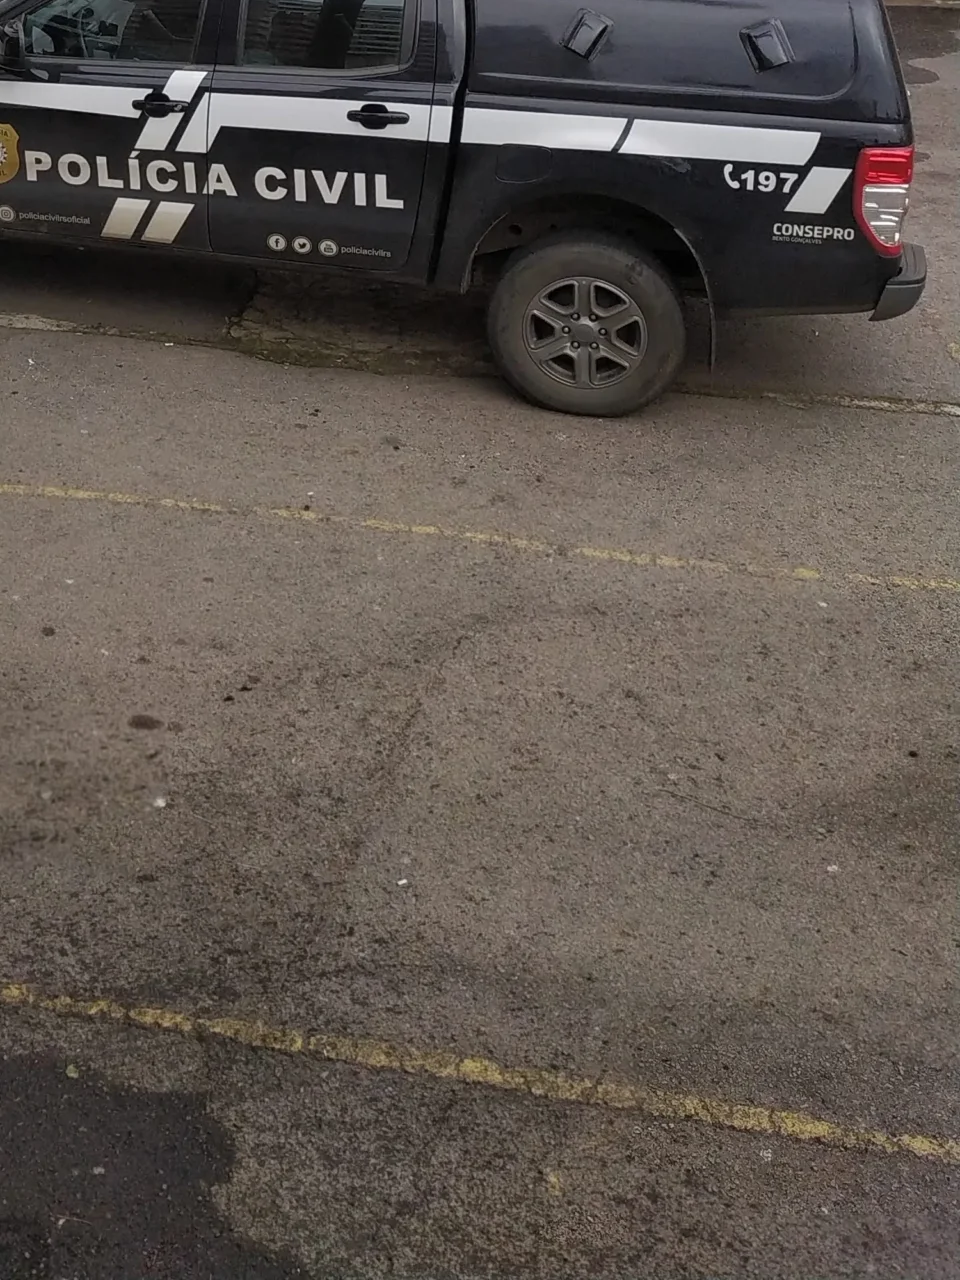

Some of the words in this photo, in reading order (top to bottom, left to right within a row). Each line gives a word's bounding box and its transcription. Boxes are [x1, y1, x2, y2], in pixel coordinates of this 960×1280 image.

[24, 150, 239, 197] POLÍCIA
[254, 166, 404, 209] CIVIL
[741, 169, 799, 193] 197
[773, 223, 855, 240] CONSEPRO
